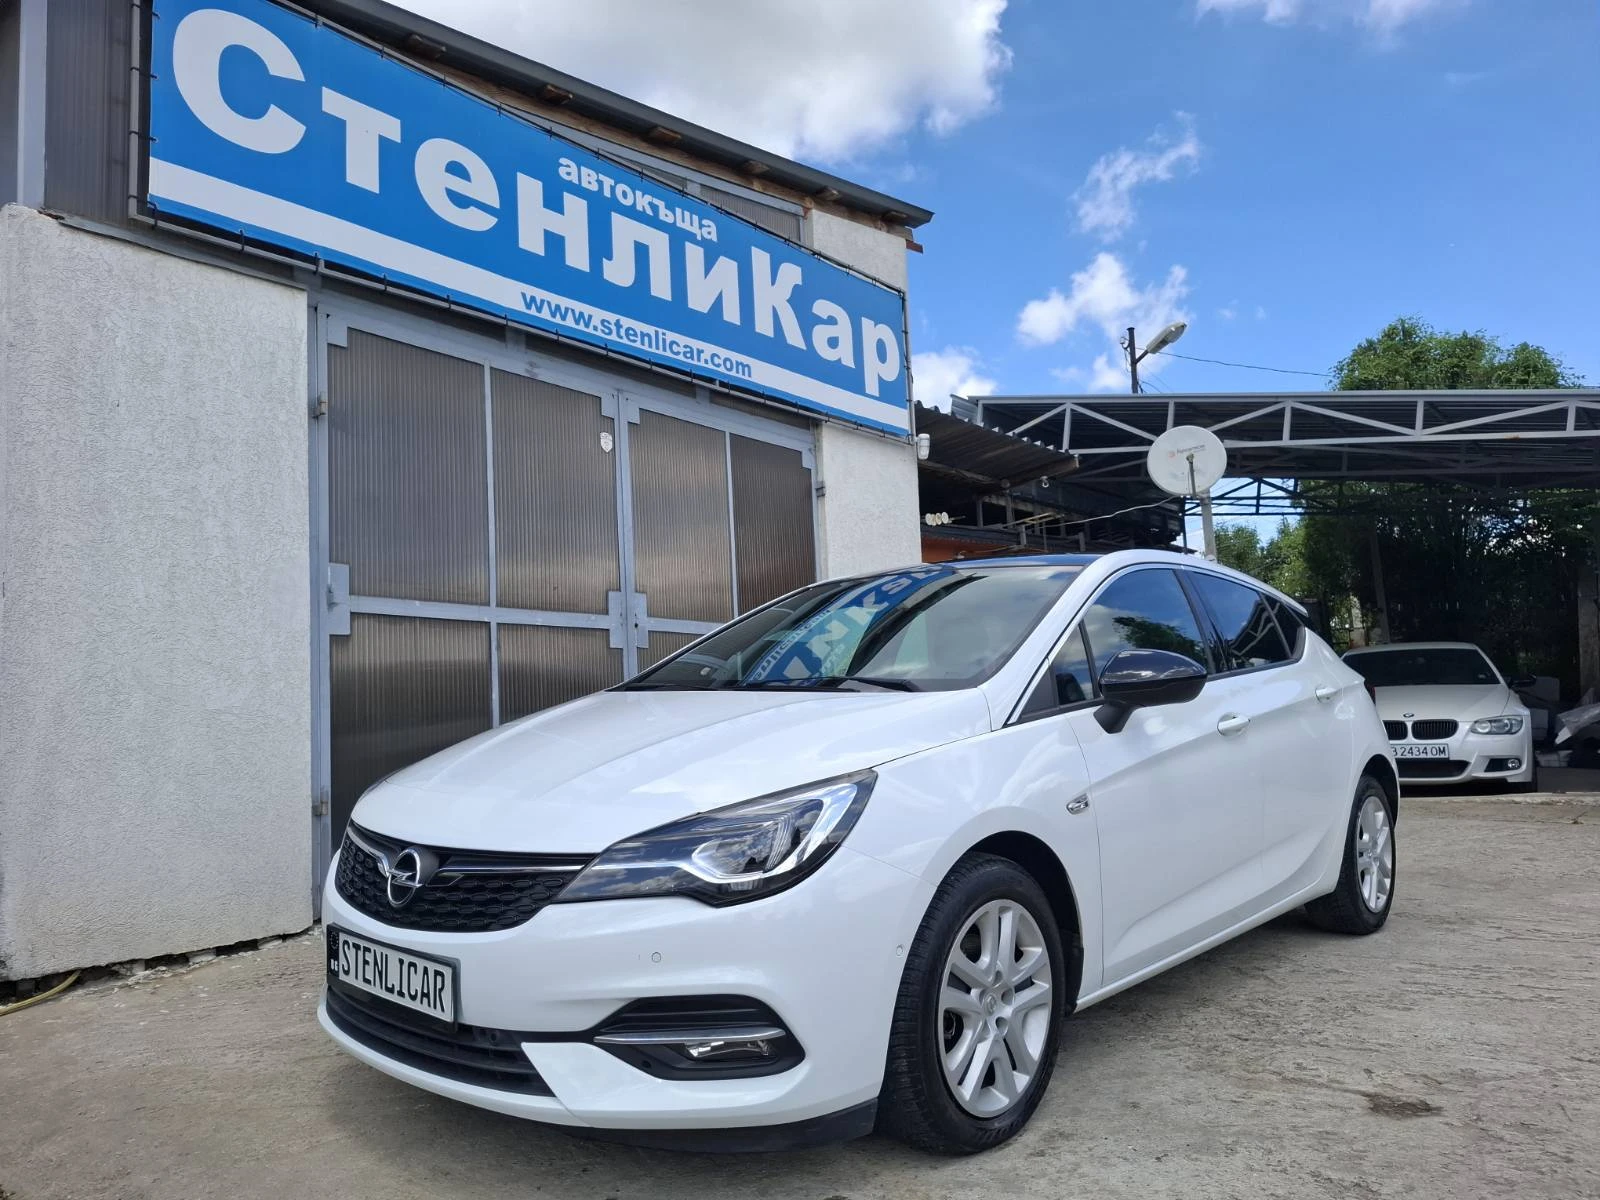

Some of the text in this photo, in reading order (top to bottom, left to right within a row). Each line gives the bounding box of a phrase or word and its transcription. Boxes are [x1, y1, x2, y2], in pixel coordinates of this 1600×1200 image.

[173, 8, 900, 397] СтенлиКар
[558, 157, 718, 242] автокъща
[520, 291, 753, 379] www.stenlicar.com
[1399, 746, 1428, 757] 2434
[341, 939, 446, 1013] STENLICAR
